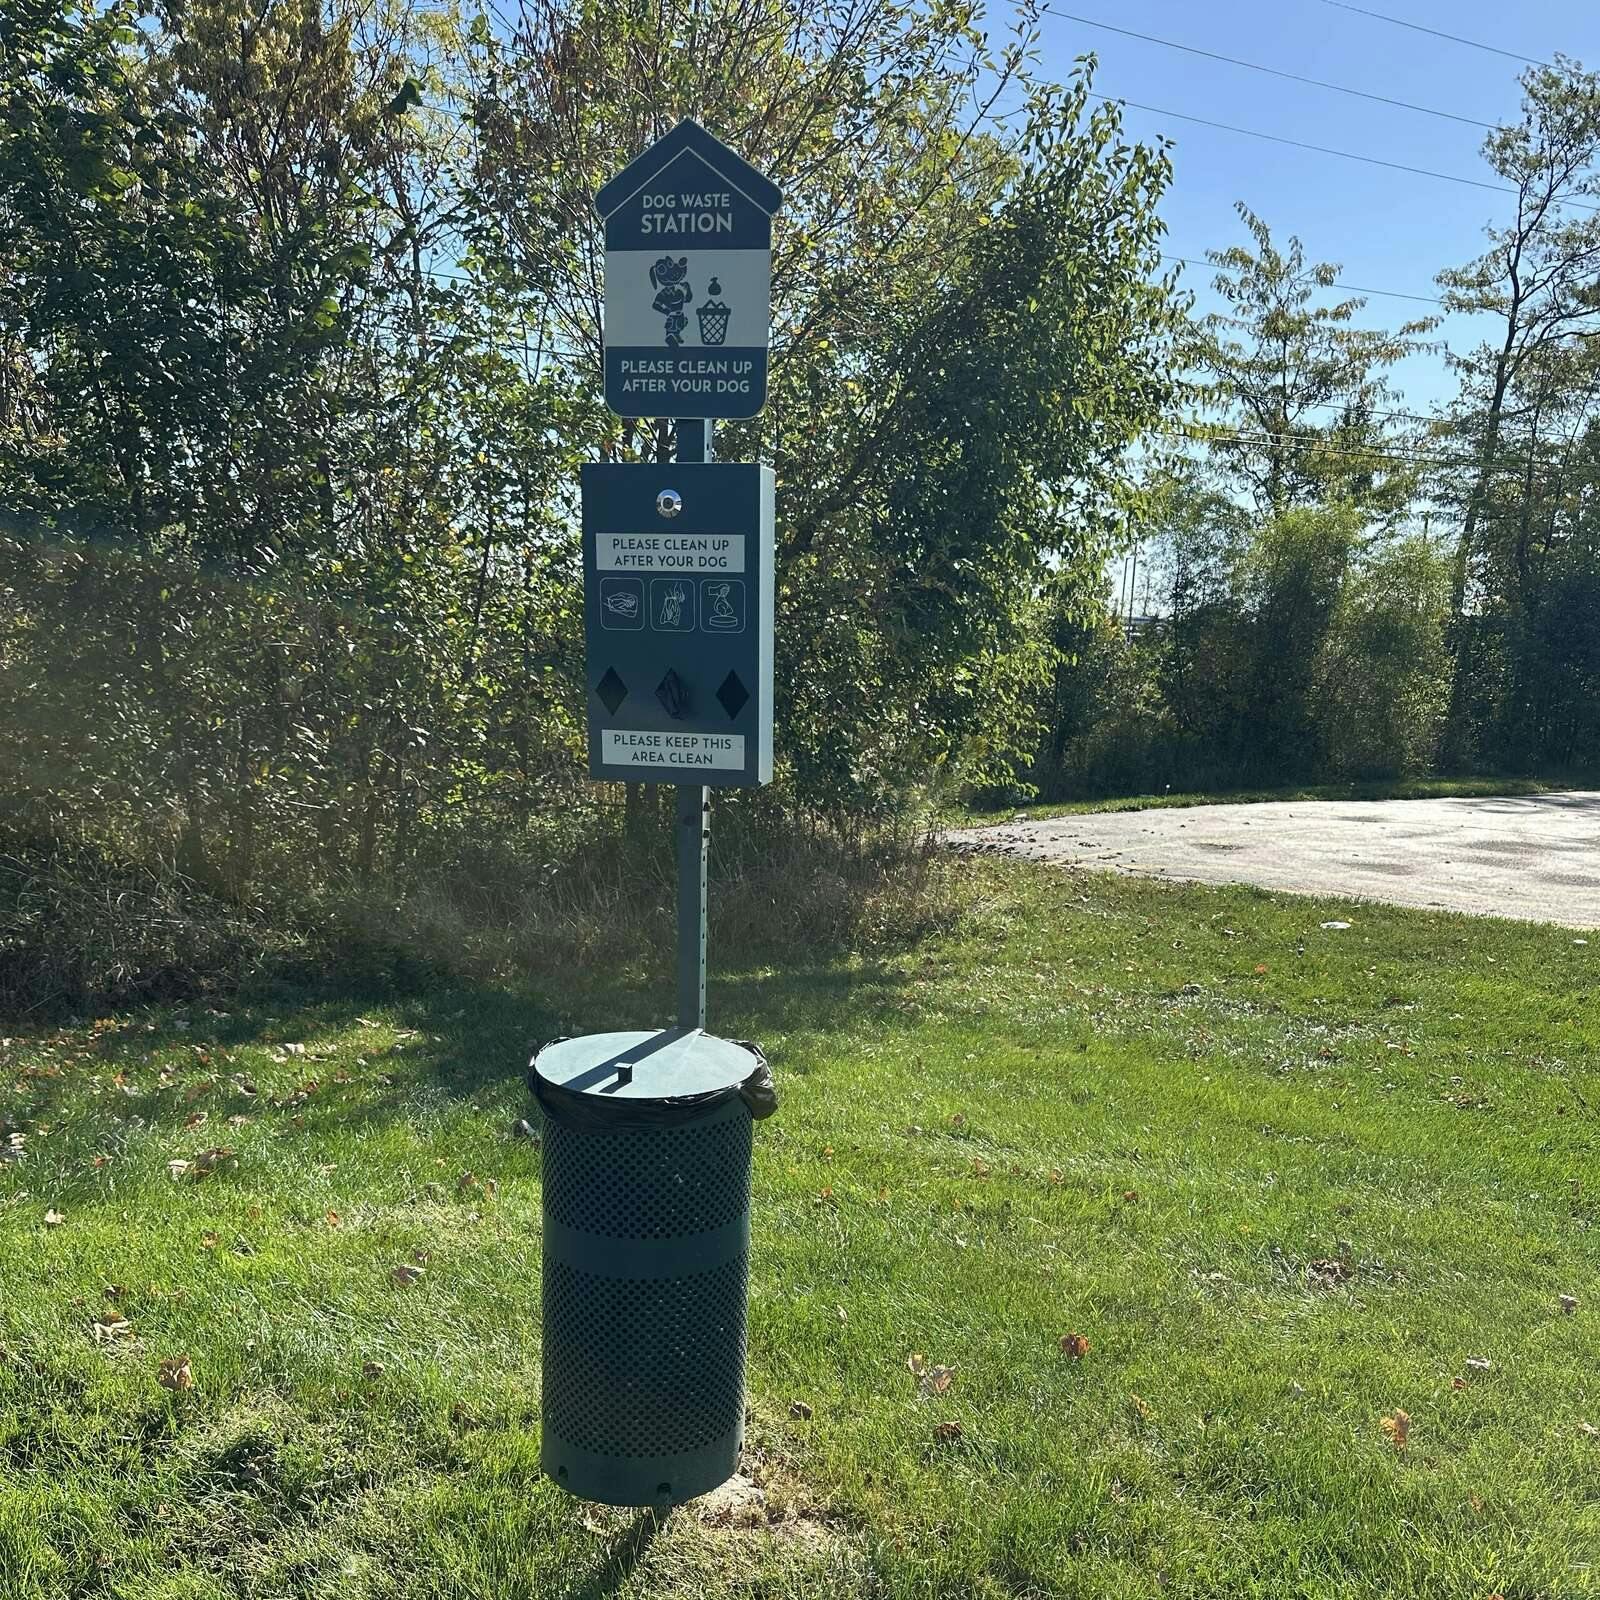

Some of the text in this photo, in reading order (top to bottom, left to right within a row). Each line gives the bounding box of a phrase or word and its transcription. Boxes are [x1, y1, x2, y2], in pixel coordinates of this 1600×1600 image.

[643, 193, 730, 208] DOG WASTE
[641, 213, 732, 234] STATION
[621, 360, 752, 375] PLEASE CLEAN UP
[622, 379, 750, 393] AFTER YOUR DOG
[612, 538, 729, 551] PLEASE CLEAN UP
[614, 555, 728, 568] AFTER YOUR DOG
[613, 734, 732, 750] PLEASE KEEP THIS
[631, 751, 713, 765] AREA CLEAN
